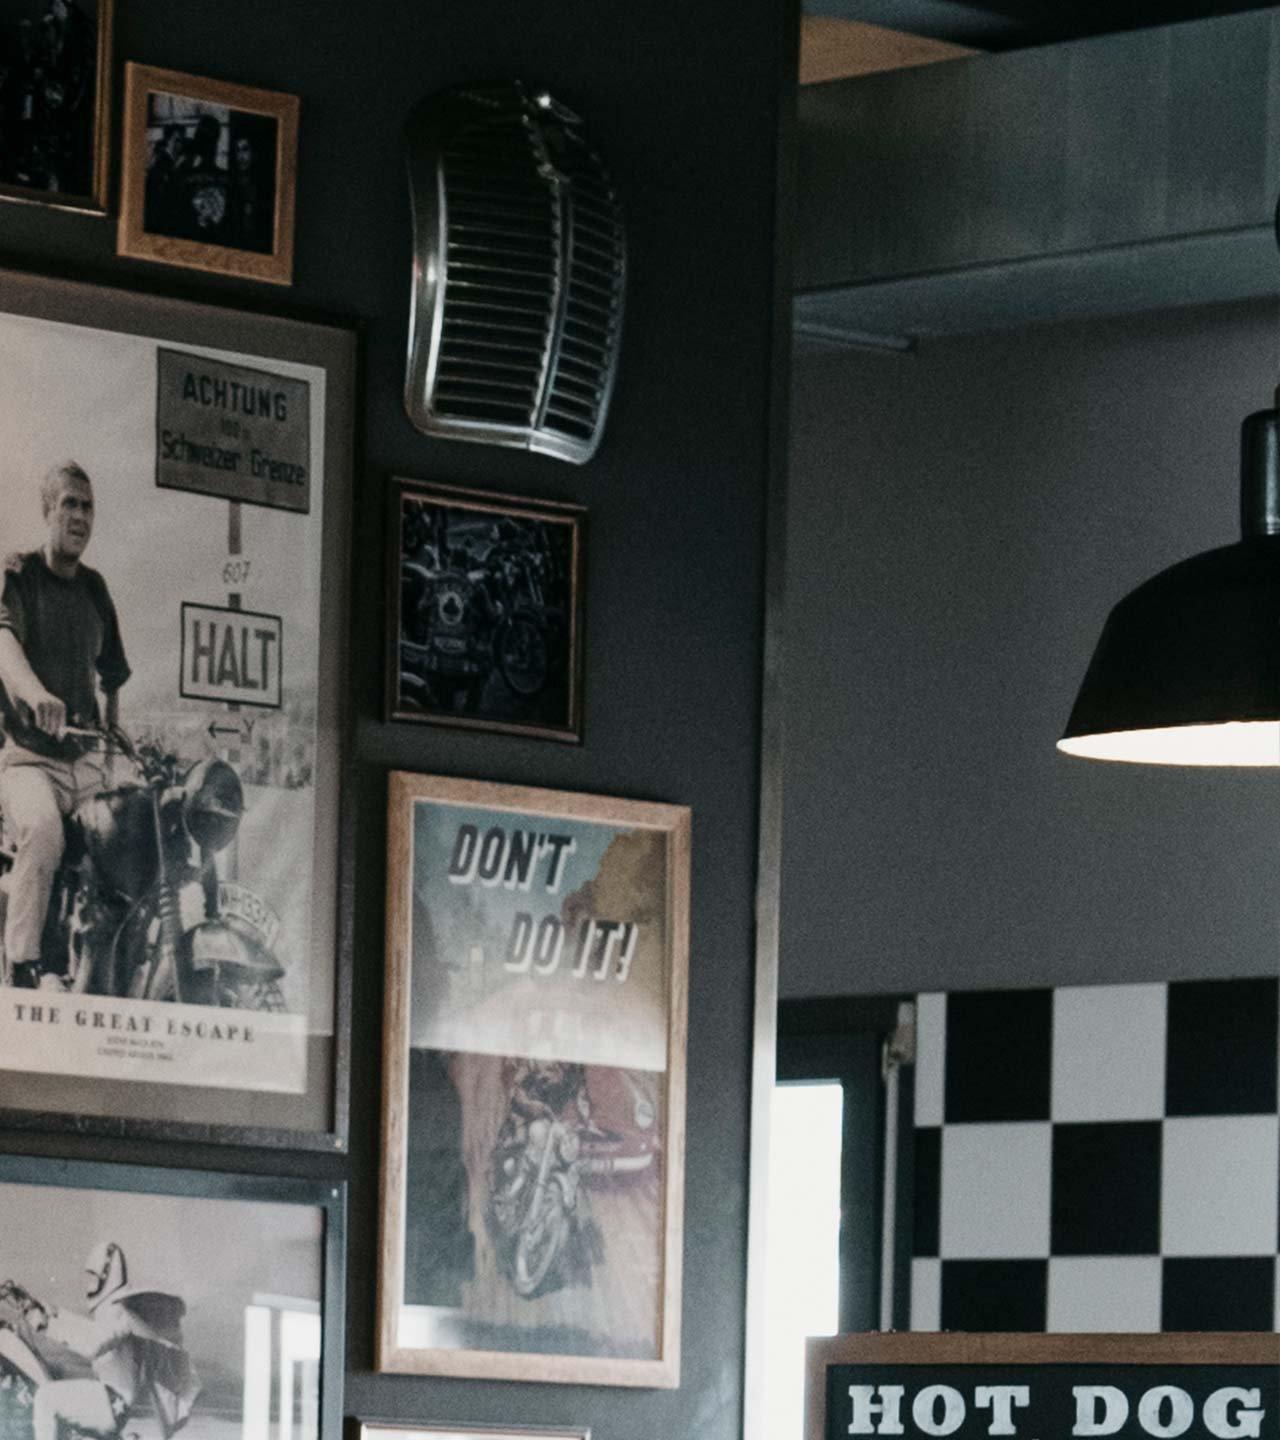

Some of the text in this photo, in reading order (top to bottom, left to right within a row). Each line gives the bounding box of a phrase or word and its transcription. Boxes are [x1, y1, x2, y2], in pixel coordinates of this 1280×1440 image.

[183, 372, 288, 422] ACHTUNG
[162, 429, 242, 471] Schweizer
[250, 448, 306, 486] Grenze
[192, 619, 276, 691] HALT
[448, 823, 576, 894] DON'T
[504, 911, 639, 982] DO IT!
[14, 1003, 61, 1025] THE
[75, 1008, 153, 1034] GREAT
[167, 1018, 256, 1044] ESCAPE
[848, 1384, 1265, 1440] HOT DOG
